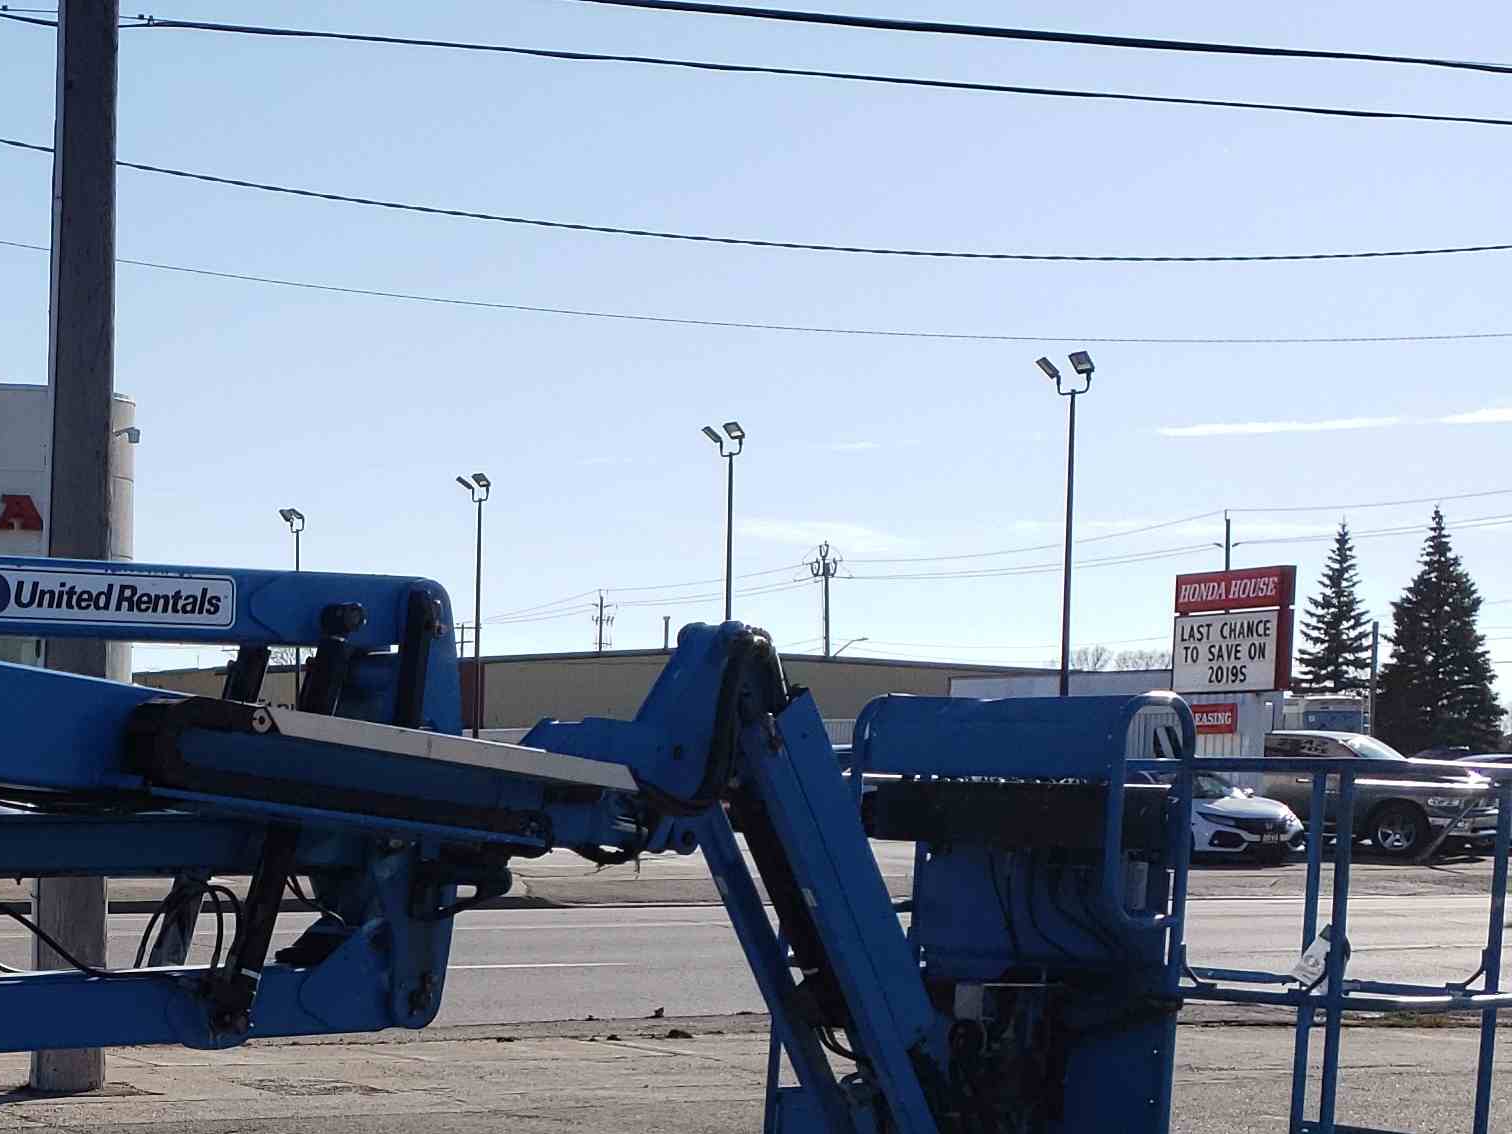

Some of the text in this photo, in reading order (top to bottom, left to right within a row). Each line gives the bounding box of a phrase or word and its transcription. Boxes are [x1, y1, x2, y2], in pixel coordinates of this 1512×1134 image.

[14, 580, 222, 615] United Rentals
[1179, 576, 1279, 603] HONDA HOUSE
[1180, 619, 1271, 642] LAST CHANCE
[1184, 642, 1266, 663] TO SAVE ON
[1208, 665, 1247, 684] 2019S
[1194, 712, 1232, 726] EASING
